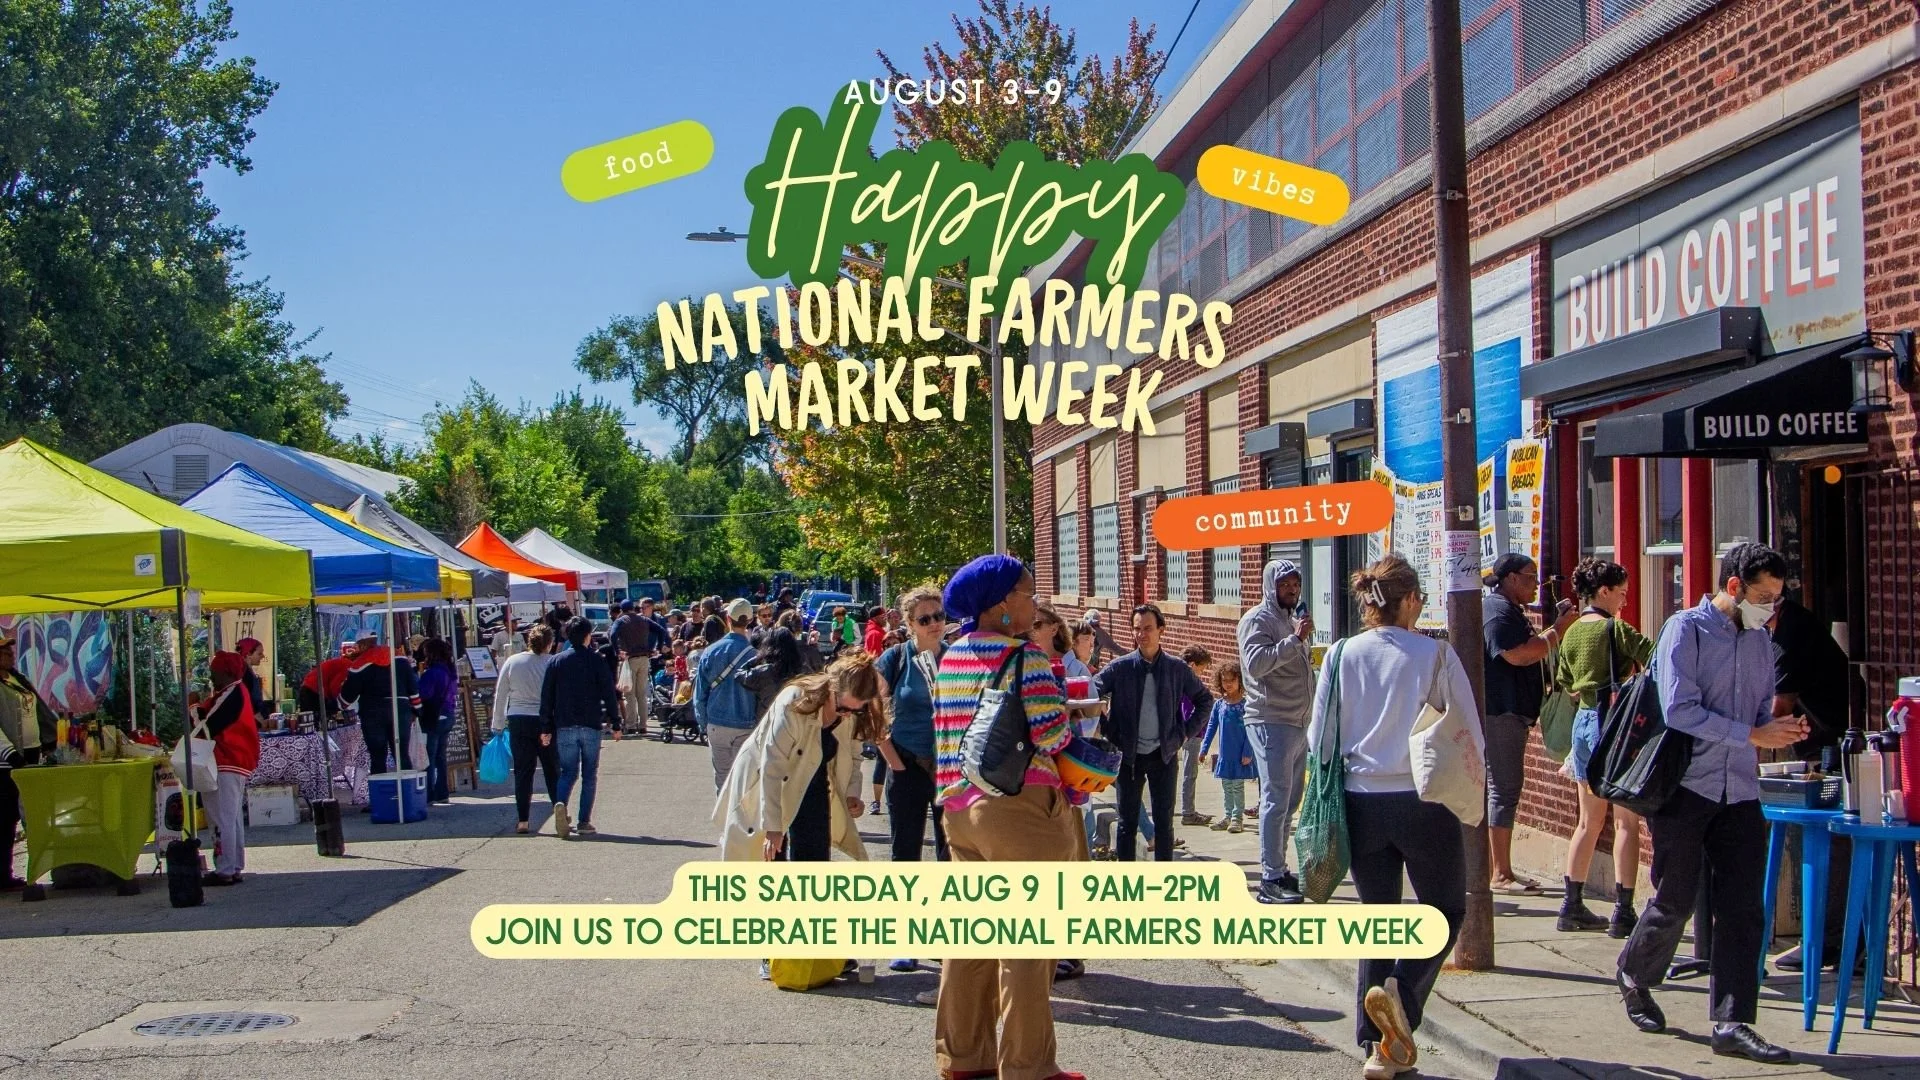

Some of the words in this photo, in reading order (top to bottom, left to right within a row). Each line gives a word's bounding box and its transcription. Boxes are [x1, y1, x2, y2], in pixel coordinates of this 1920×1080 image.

[1568, 246, 1667, 350] BUILD
[1678, 176, 1840, 318] COFFEE
[1704, 414, 1770, 438] BUILD
[1778, 412, 1858, 436] COFFEE
[1511, 473, 1536, 490] BREADS
[1483, 490, 1491, 514] 12
